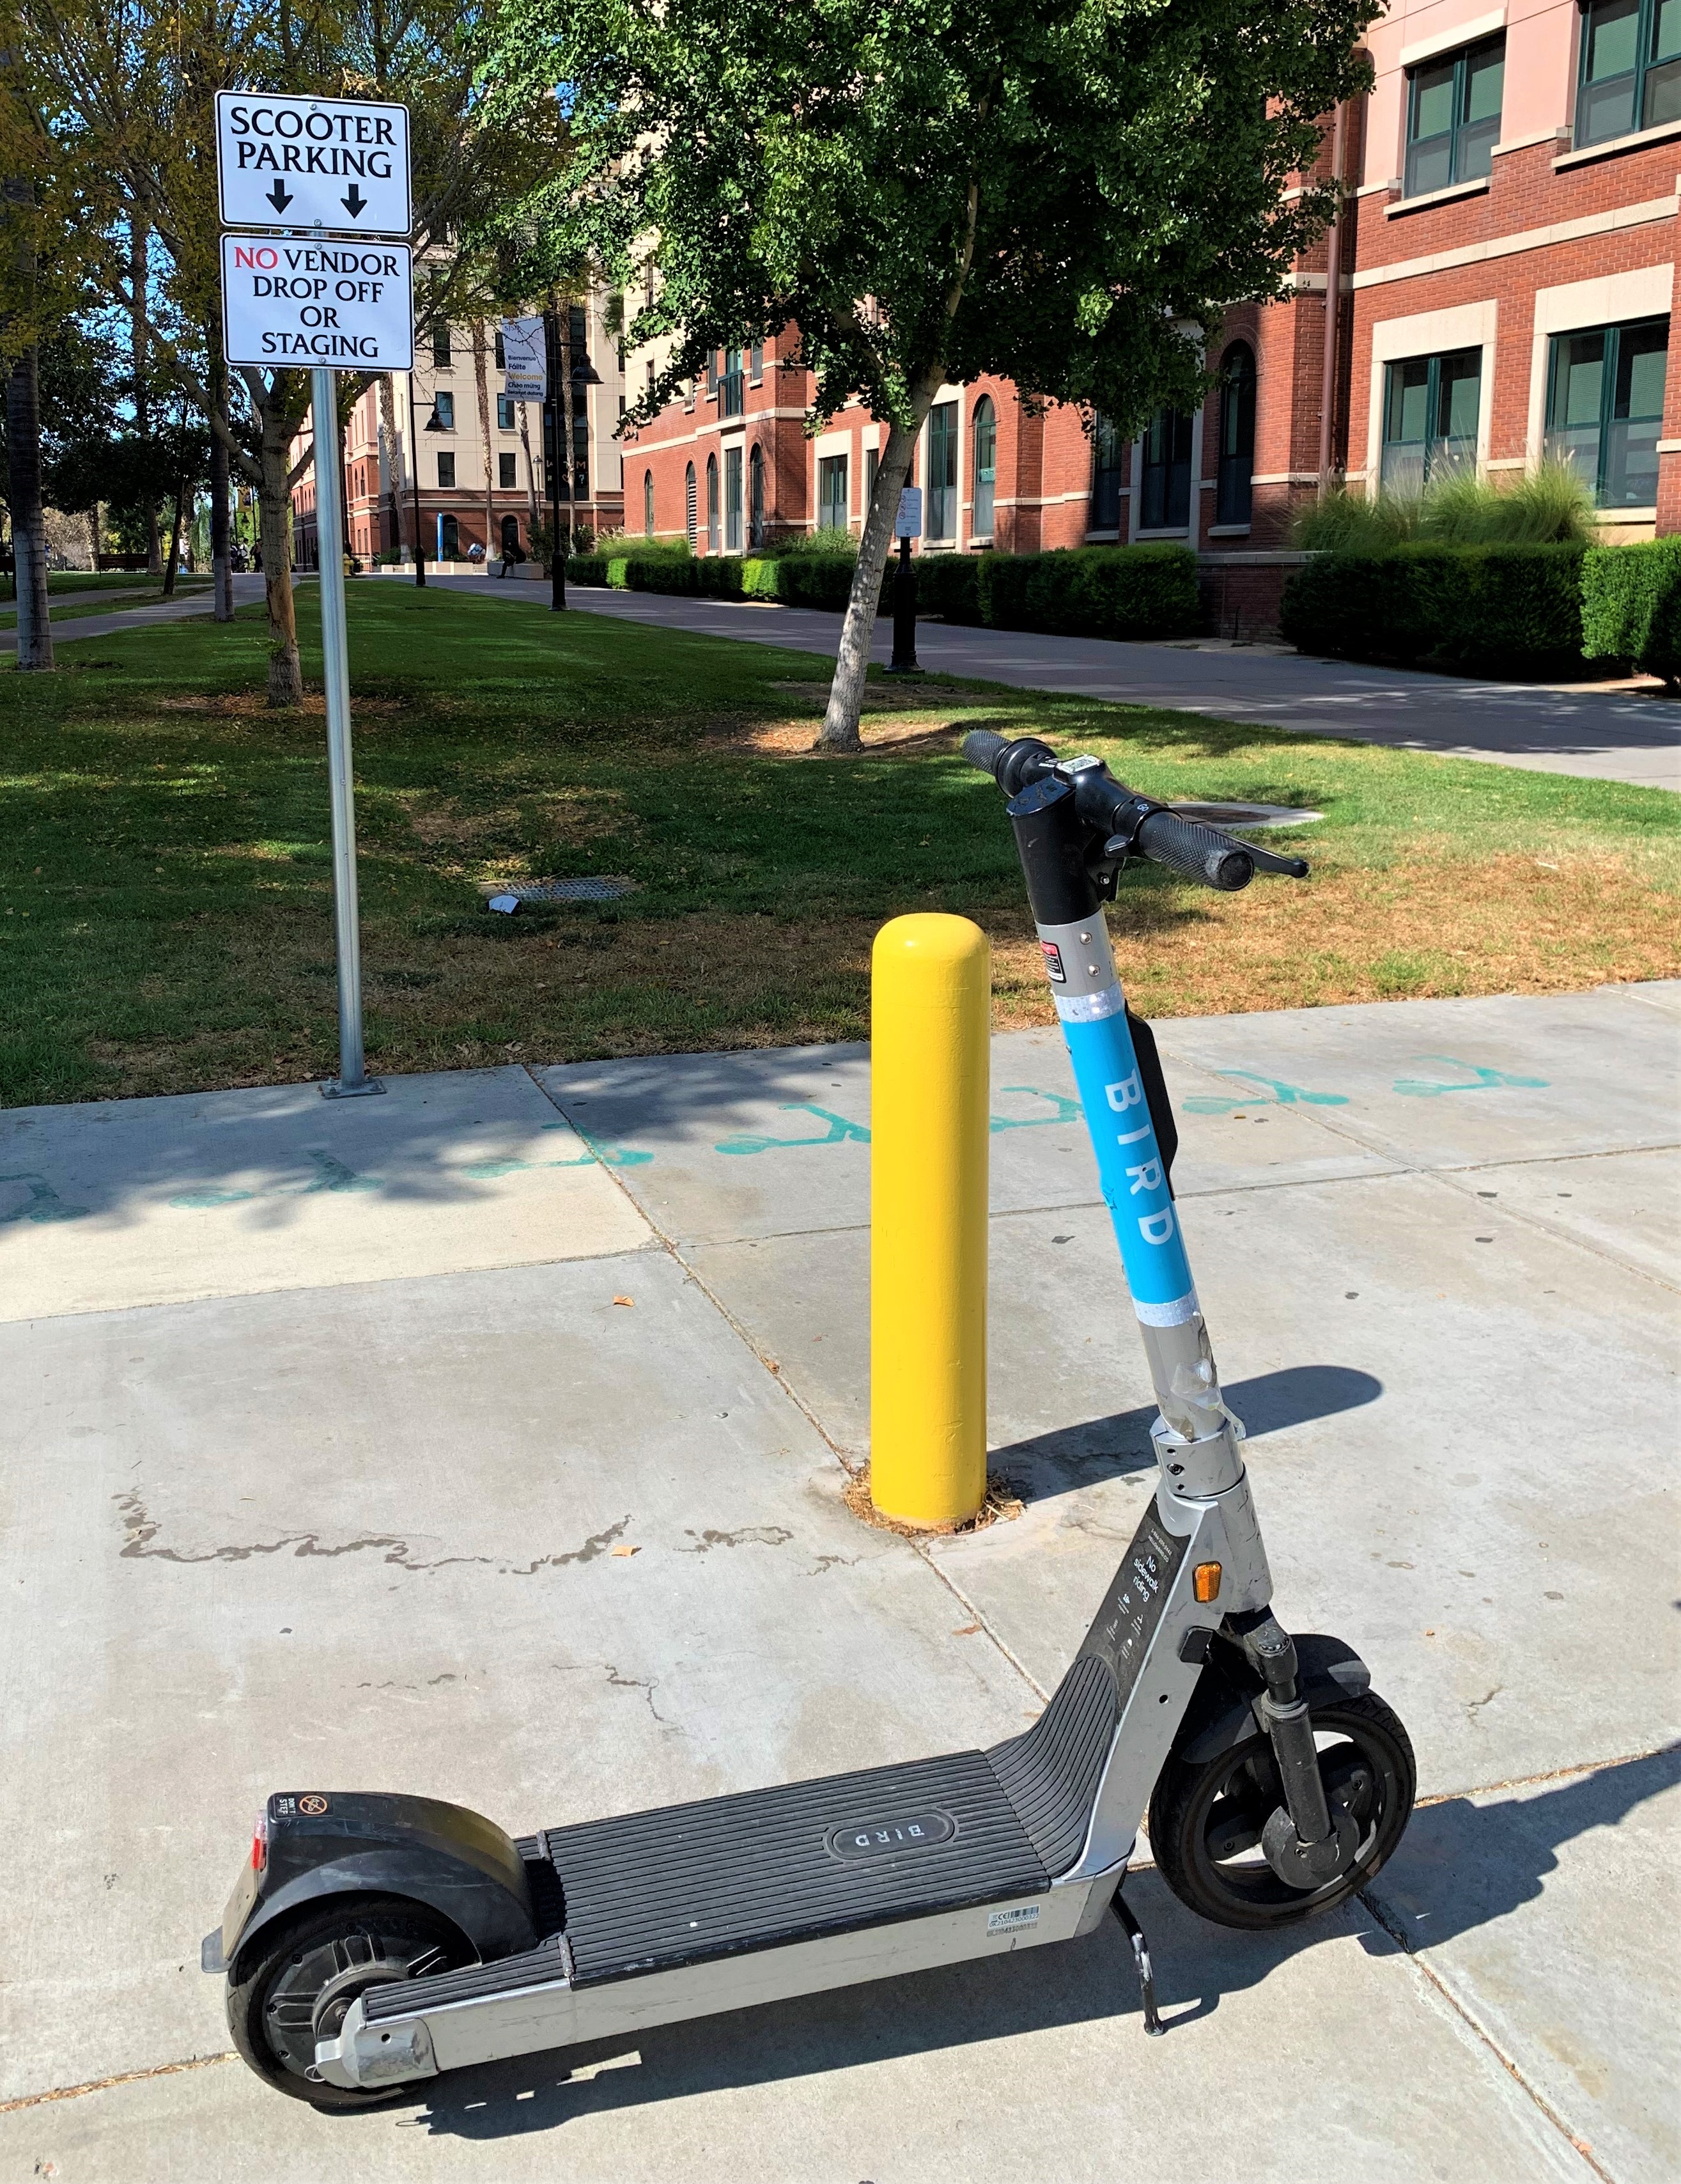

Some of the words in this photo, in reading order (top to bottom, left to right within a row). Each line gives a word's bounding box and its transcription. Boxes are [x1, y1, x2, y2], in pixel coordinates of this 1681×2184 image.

[231, 107, 398, 146] SCOOTER
[236, 141, 392, 178] PARKING
[234, 247, 278, 269] NO
[285, 249, 400, 276] VENDOR
[253, 276, 327, 299] DROP
[336, 280, 384, 303] OFF
[300, 306, 341, 329] OR
[262, 332, 378, 358] STAGING
[1104, 1068, 1174, 1245] BIRD
[1133, 1558, 1159, 1593] sidewalk
[1146, 1556, 1156, 1573] No
[1133, 1576, 1150, 1602] riding
[279, 1798, 288, 1814] STEP
[288, 1798, 297, 1814] DON'T
[855, 1825, 924, 1846] BIRD
